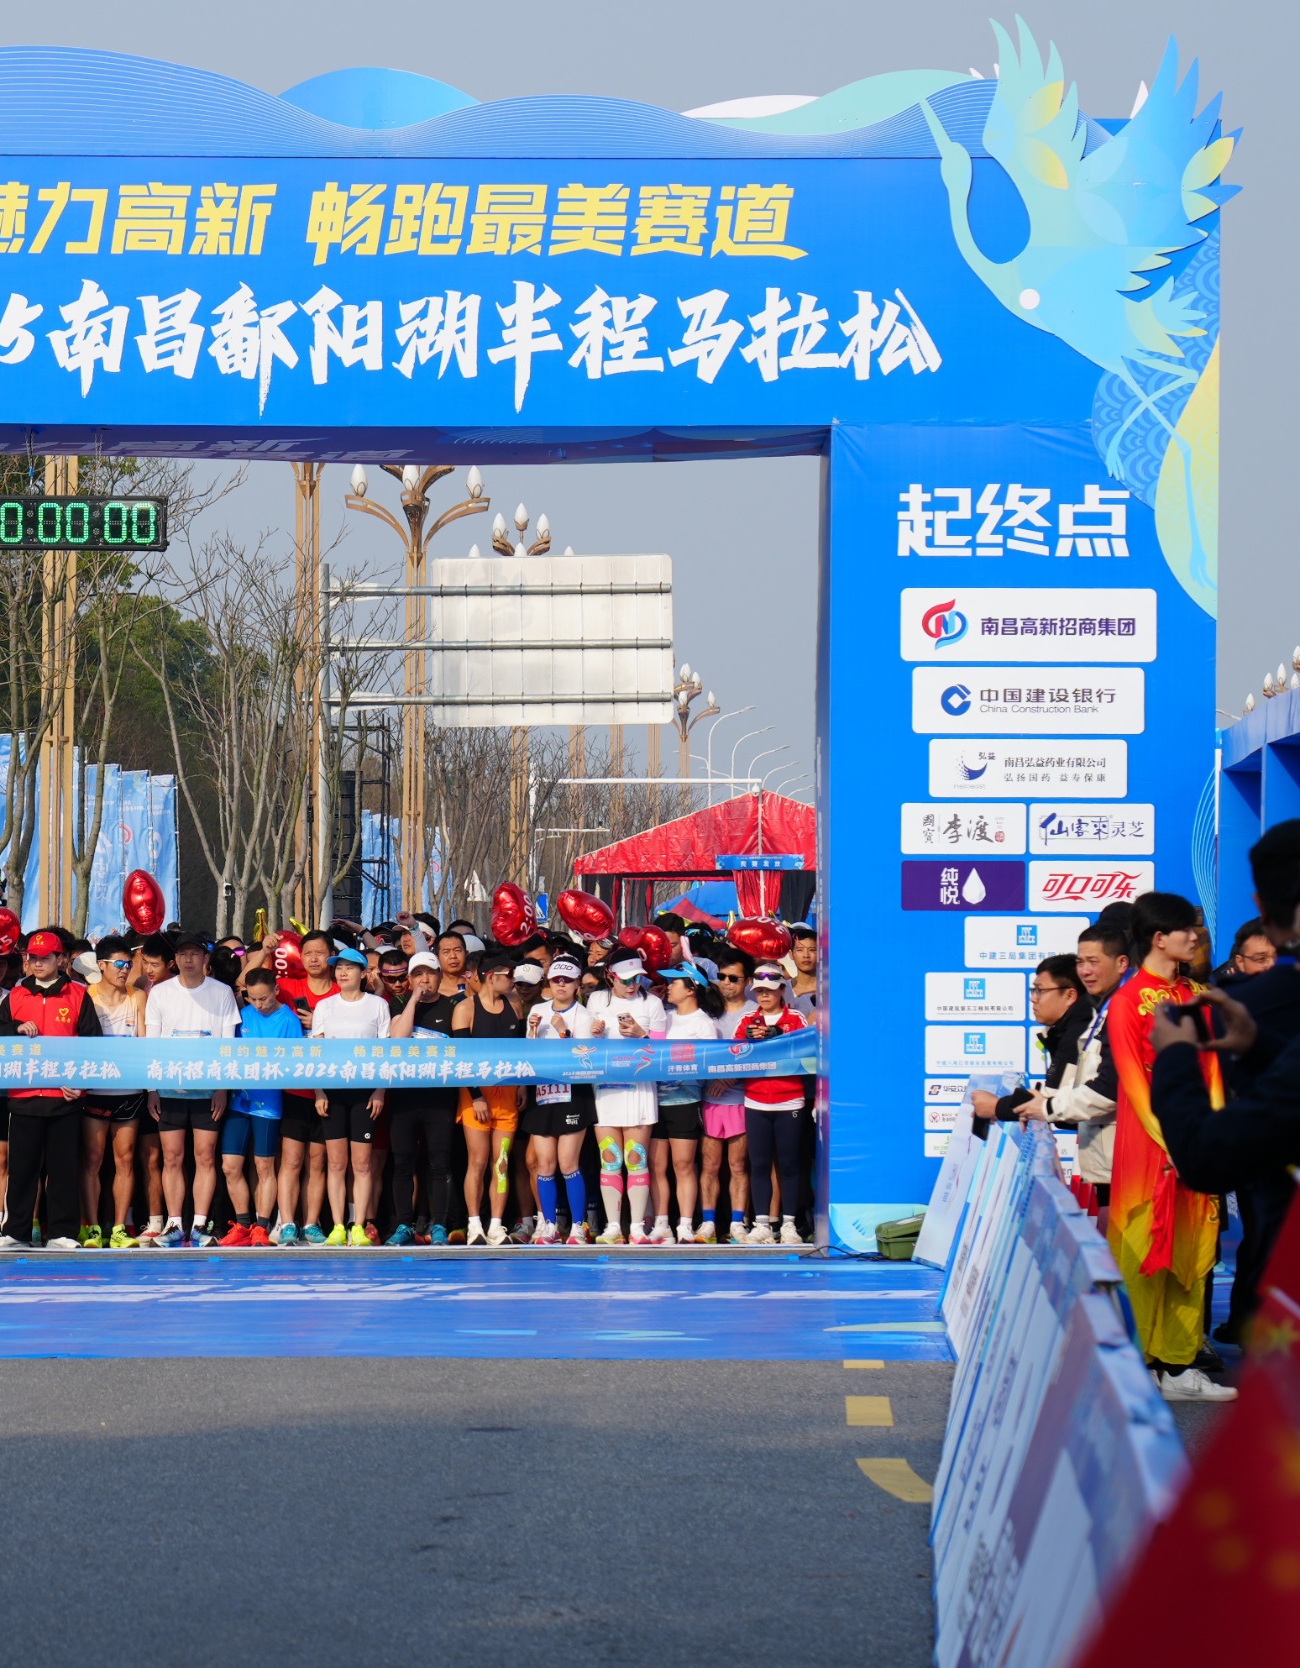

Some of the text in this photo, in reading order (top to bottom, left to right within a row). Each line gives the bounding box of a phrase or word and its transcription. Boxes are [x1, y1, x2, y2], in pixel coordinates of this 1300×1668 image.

[305, 182, 809, 267] 畅跑最美赛道
[897, 483, 1130, 557] 起终点
[981, 617, 1136, 637] 南昌高新招商集团
[980, 688, 1116, 704] 中国建设银行
[980, 704, 1099, 713] China Construction Bank
[978, 752, 996, 760] 弘益
[1004, 757, 1107, 768] 南昌弘益药业有限公司
[1004, 773, 1107, 783] 弘扬国药 益寿保康
[943, 813, 995, 844] 李渡
[940, 867, 960, 905] 纯悦
[1042, 871, 1143, 901] 可口可乐
[219, 1045, 457, 1058] 相约魅力高新 畅跑最美赛道
[667, 1063, 699, 1073] 汗青体育
